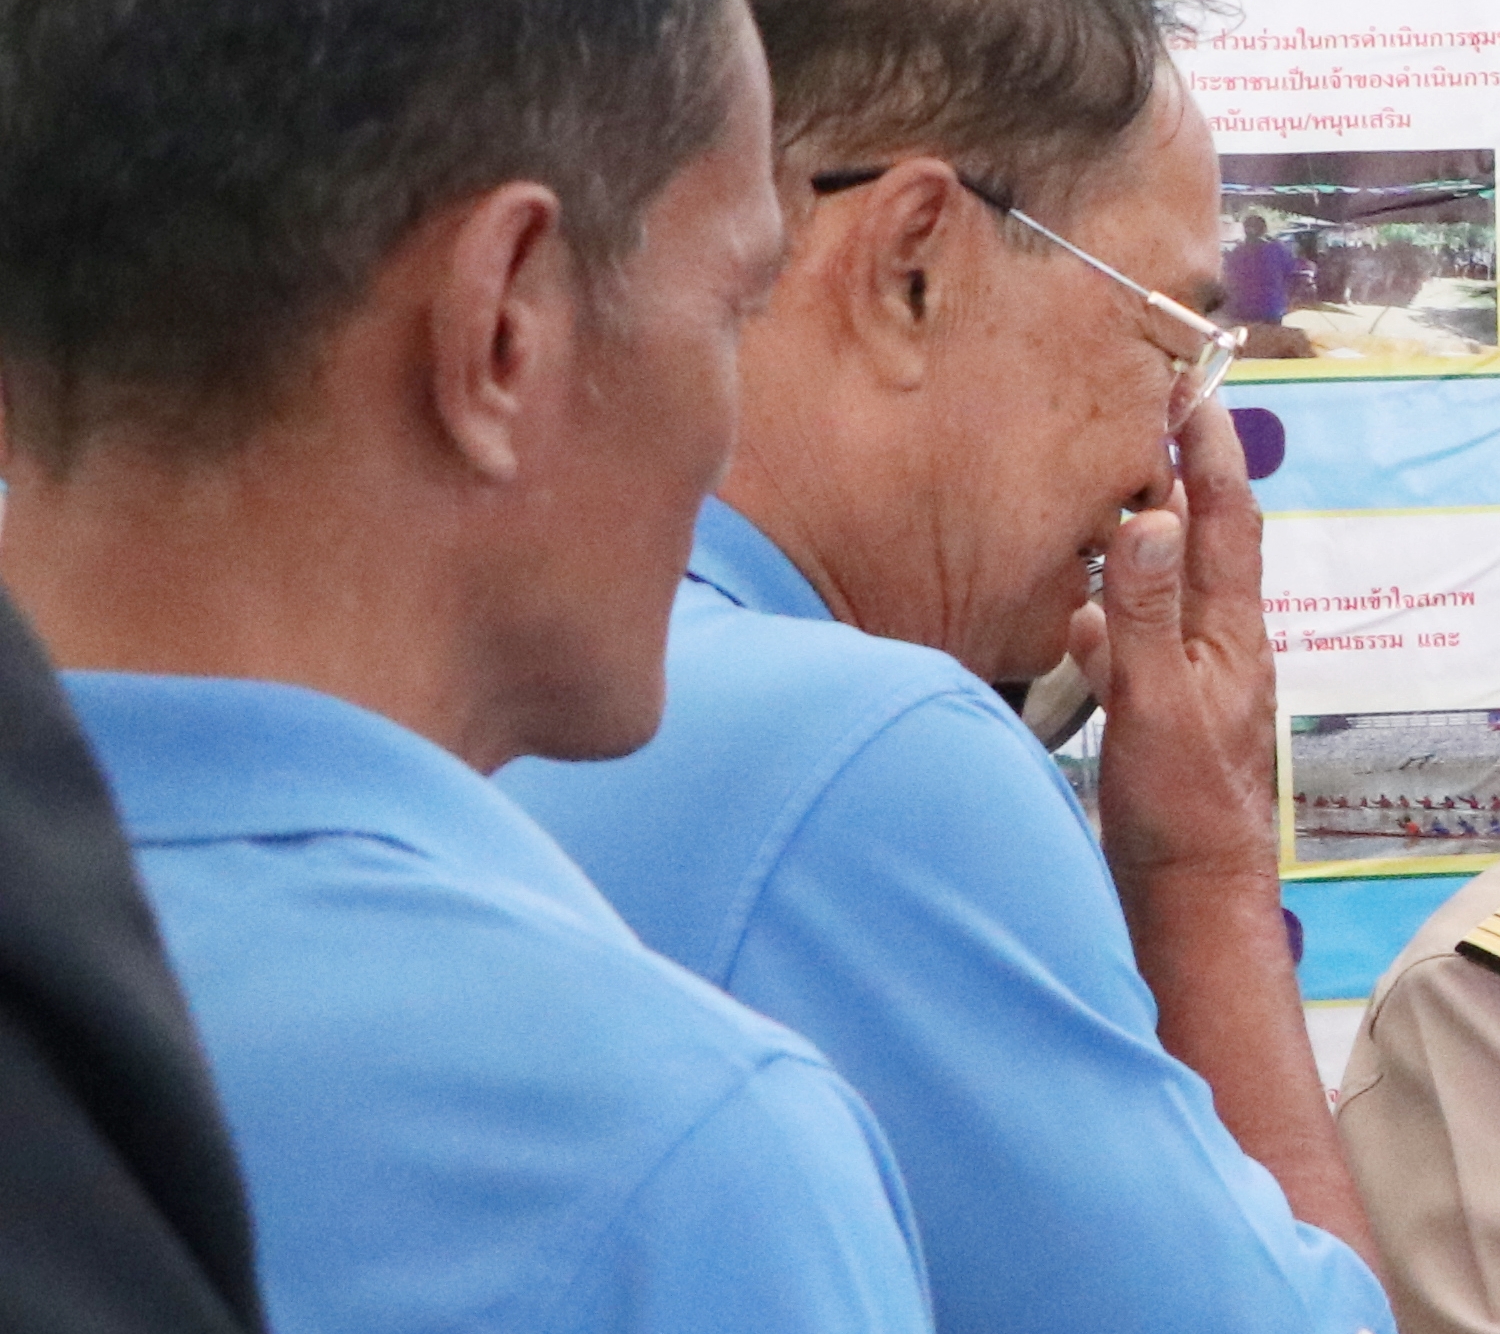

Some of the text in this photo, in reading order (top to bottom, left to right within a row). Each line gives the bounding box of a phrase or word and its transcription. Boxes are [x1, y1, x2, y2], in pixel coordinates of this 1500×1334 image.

[1208, 105, 1412, 138] สนับสนุน/หนุนเสริม
[1262, 586, 1476, 614] อทำความเข้าใจสภาพ
[1301, 630, 1404, 652] วัฒนธรรม
[1416, 631, 1460, 648] และ
